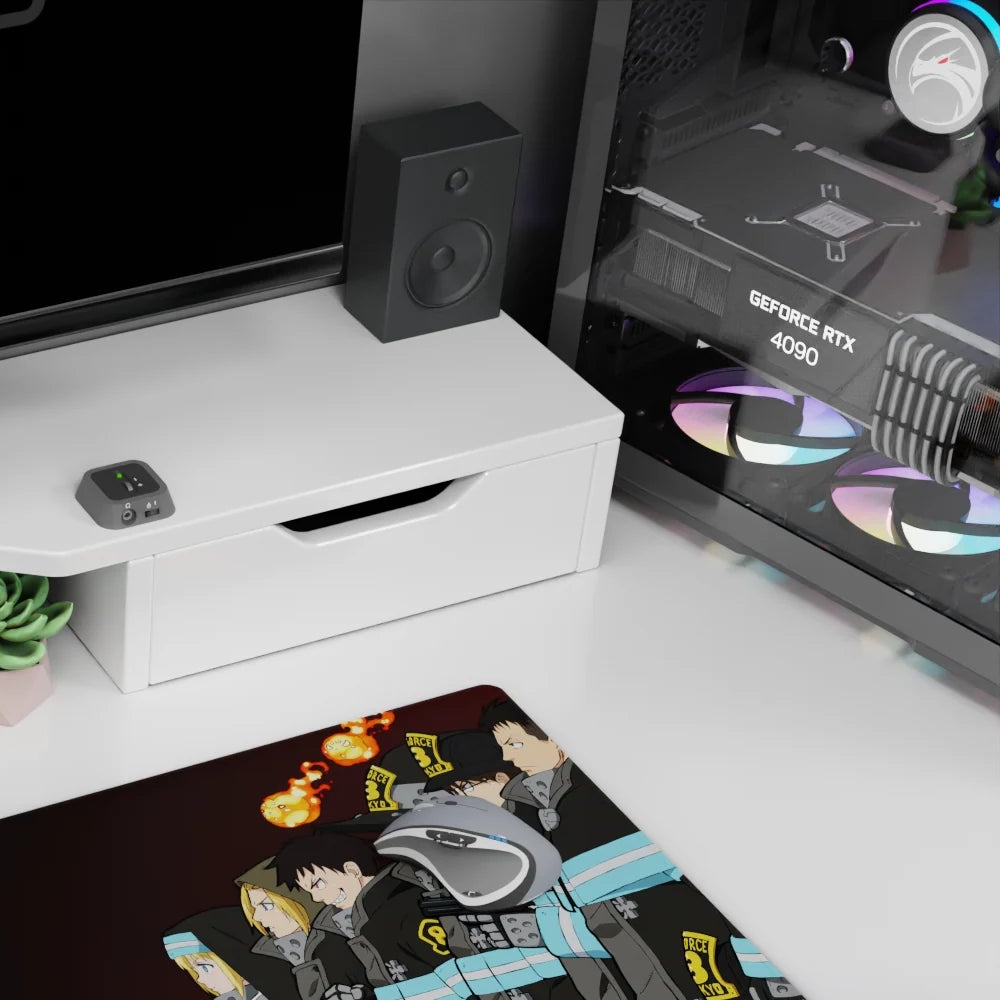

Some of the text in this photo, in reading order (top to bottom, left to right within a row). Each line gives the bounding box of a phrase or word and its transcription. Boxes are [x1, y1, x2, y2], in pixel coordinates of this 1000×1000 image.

[749, 289, 856, 354] GEFORCE RTX
[770, 331, 819, 366] 4090
[685, 950, 709, 985] 3
